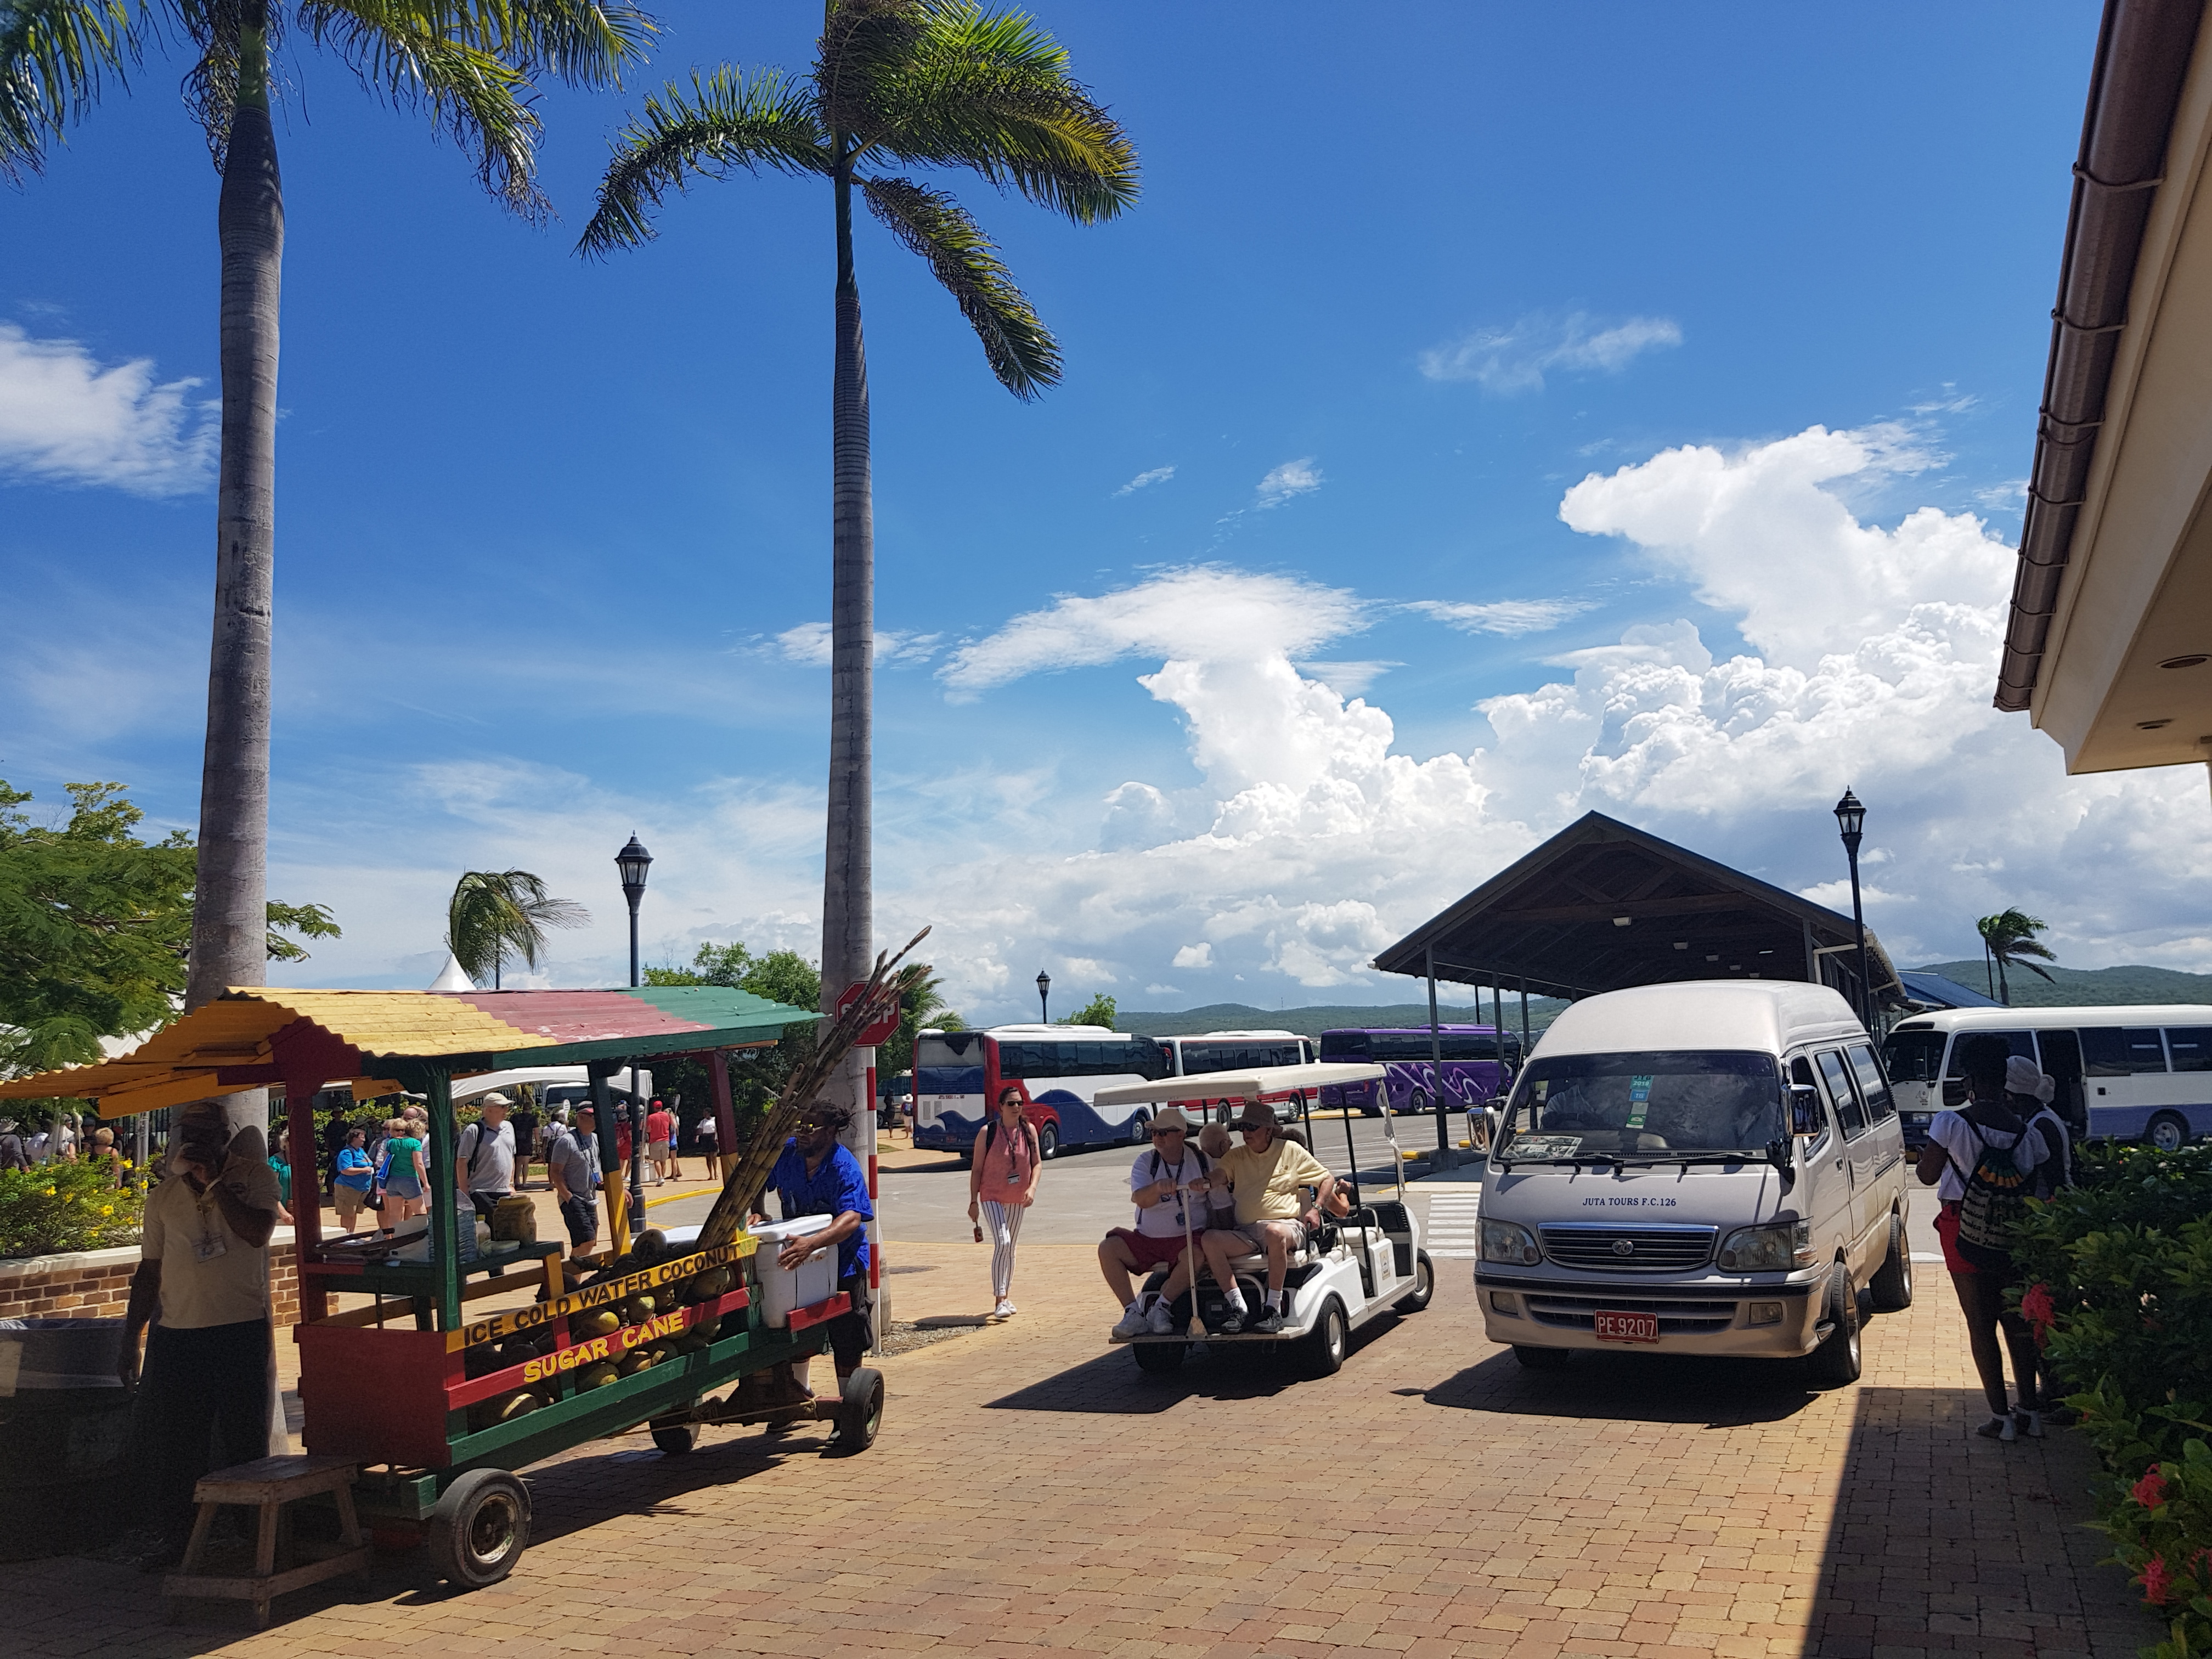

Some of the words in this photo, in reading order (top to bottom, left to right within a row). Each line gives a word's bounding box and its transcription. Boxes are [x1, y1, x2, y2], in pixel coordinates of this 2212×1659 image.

[1609, 1198, 1639, 1206] TOURS
[1642, 1198, 1677, 1206] F.C.126
[464, 1317, 503, 1346] ICE
[515, 1297, 571, 1329] COLD
[579, 1272, 653, 1307] WATER
[659, 1243, 740, 1282] COCONUT
[523, 1338, 610, 1383] SUGAR
[622, 1312, 684, 1348] CANE
